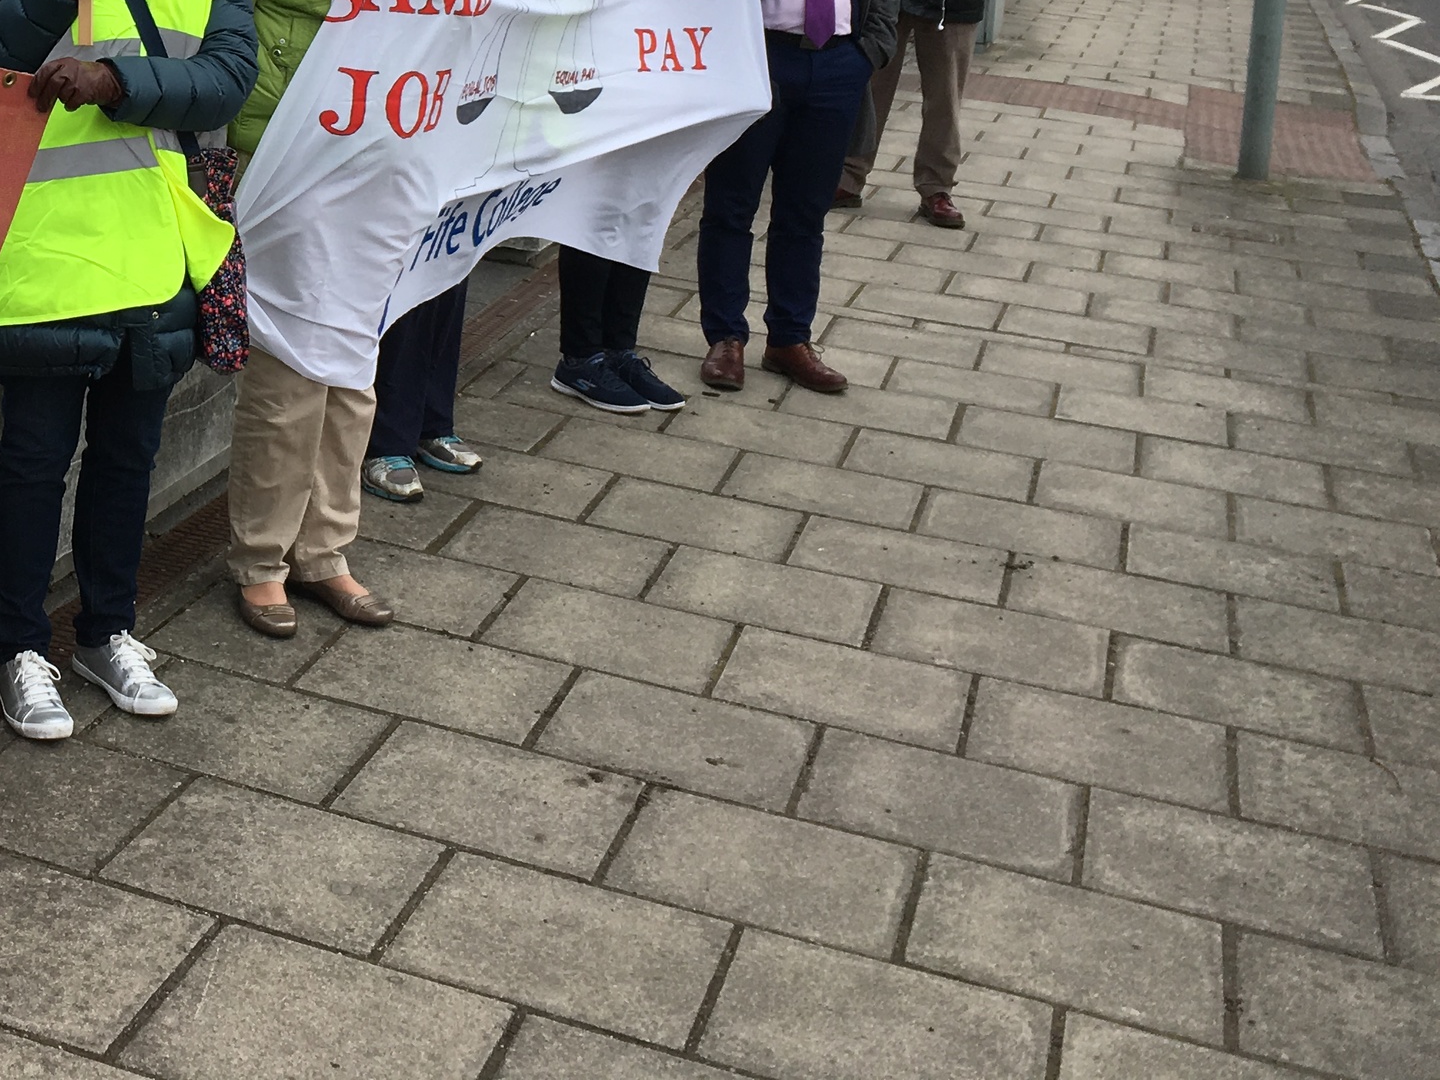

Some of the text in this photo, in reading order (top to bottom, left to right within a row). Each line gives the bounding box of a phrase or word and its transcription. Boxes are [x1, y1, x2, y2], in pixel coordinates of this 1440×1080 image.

[555, 67, 595, 86] EQUAL PAY
[634, 26, 712, 72] PAY
[319, 66, 452, 139] JOB
[472, 177, 562, 248] College
